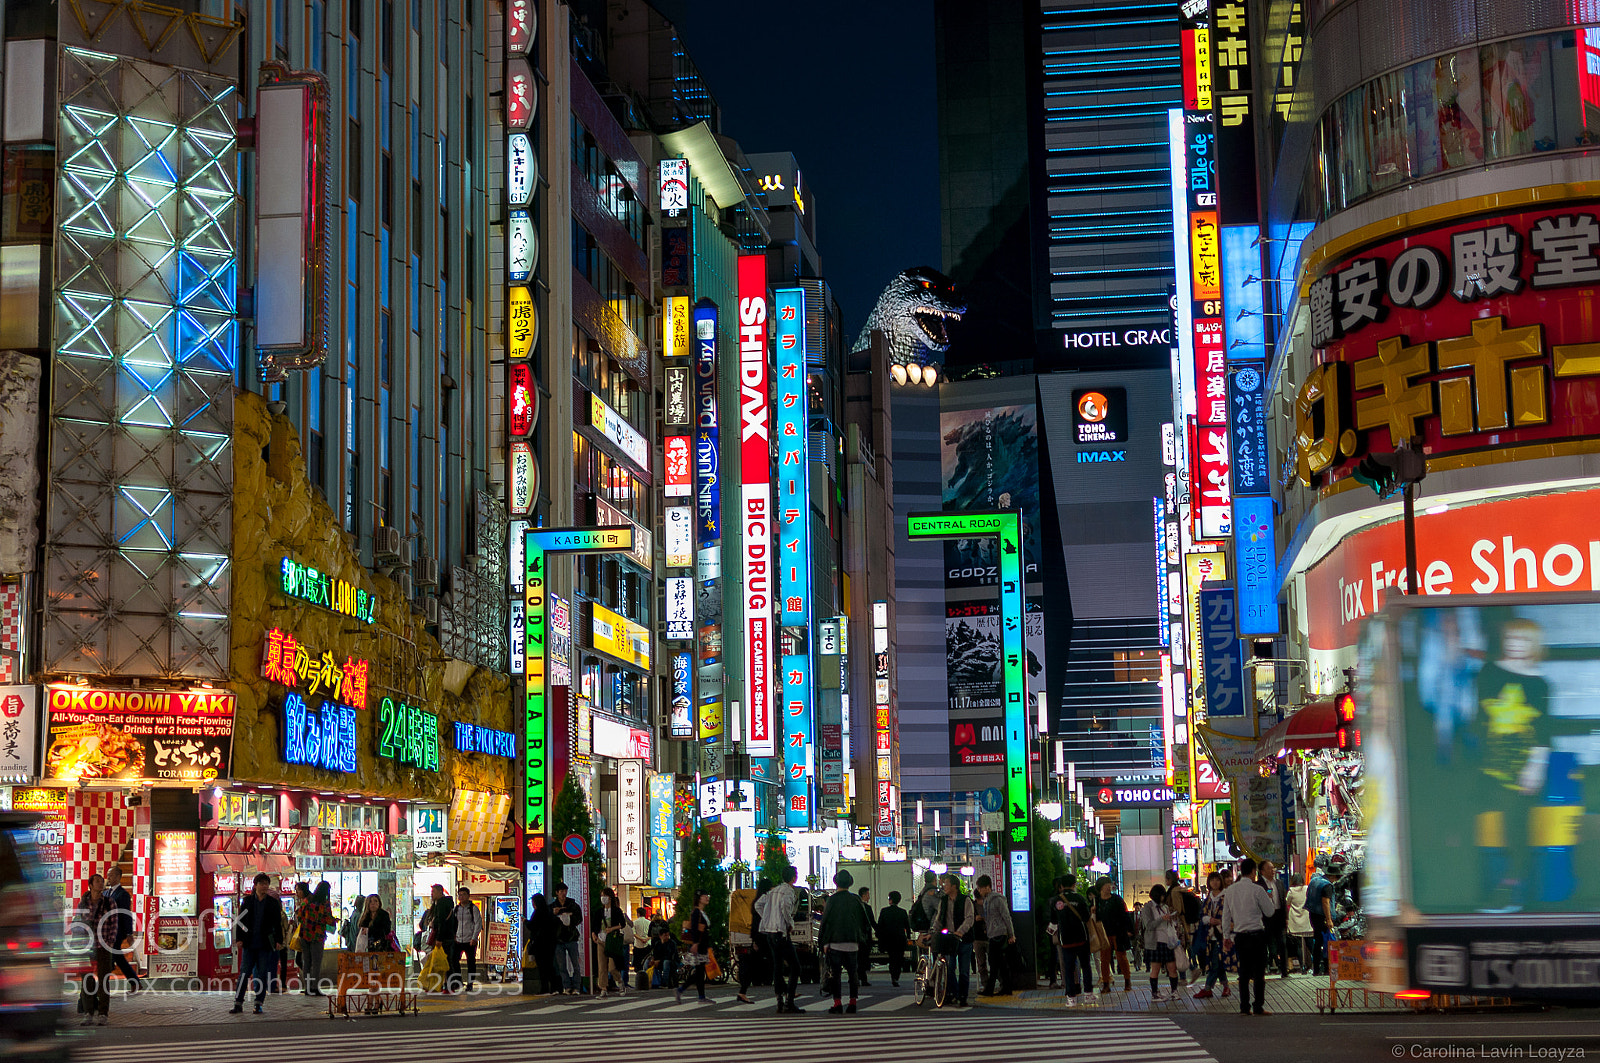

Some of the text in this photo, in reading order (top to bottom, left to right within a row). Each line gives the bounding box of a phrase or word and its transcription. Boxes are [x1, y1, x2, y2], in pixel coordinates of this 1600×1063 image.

[510, 74, 531, 112] つぼ八
[1187, 115, 1206, 124] New
[1190, 133, 1209, 191] Elle de
[511, 193, 528, 203] 6F
[668, 209, 680, 217] 8F
[1310, 213, 1600, 348] 驚安の殿堂
[1203, 301, 1222, 315] 6F
[512, 305, 532, 341] 虎の子
[1064, 331, 1121, 349] HOTEL
[511, 347, 525, 355] 4F
[739, 297, 768, 443] SHIDAX
[1205, 350, 1227, 423] 居楽屋
[1078, 424, 1106, 433] TOHO
[1078, 431, 1116, 441] CINEMAS
[781, 305, 803, 612] カラオケ&パーティー館
[1077, 450, 1126, 463] IMAX
[516, 454, 528, 507] お好み焼き
[698, 442, 717, 518] SHINJUKU
[913, 518, 1001, 531] CENTRAL ROAD
[673, 555, 686, 565] 3F
[747, 498, 767, 610] BIC DRUG
[948, 564, 1039, 579] GODZA
[1245, 547, 1266, 591] IDOL STAGE
[1338, 576, 1366, 626] Tax
[1470, 535, 1600, 595] Sho
[1248, 604, 1269, 618] 5F
[753, 621, 763, 639] BIC
[1208, 594, 1239, 712] カラオケ
[673, 655, 688, 694] 海の家
[1003, 580, 1023, 778] ゴジラロード
[52, 690, 234, 715] OKONOMI YAKI
[527, 577, 543, 808] GODZILLA ROAD
[8, 697, 19, 714] 旨
[52, 713, 232, 727] All-You-Can-Eat dinner with Free-Flowing
[2, 719, 21, 760] 蕎麦
[123, 725, 231, 736] Drinks for 2 hours ¥2,700
[285, 691, 358, 774] 飲み放題
[377, 696, 439, 772] 24時間
[454, 721, 516, 759] THE PICK PECK
[789, 670, 807, 812] カラオケ館
[823, 750, 841, 758] Cafe
[157, 769, 202, 778] TORADYU
[1198, 763, 1219, 783] 2
[14, 789, 66, 802] お好み焼き
[707, 785, 718, 814] 牛かつ
[1115, 789, 1152, 802] TOHO
[658, 800, 672, 837] Miami
[155, 832, 196, 840] OKONOMI
[165, 840, 187, 849] YAKI
[335, 829, 386, 857] カラオケBOX
[416, 839, 446, 849] 虎の子
[155, 963, 189, 973] ¥2,700
